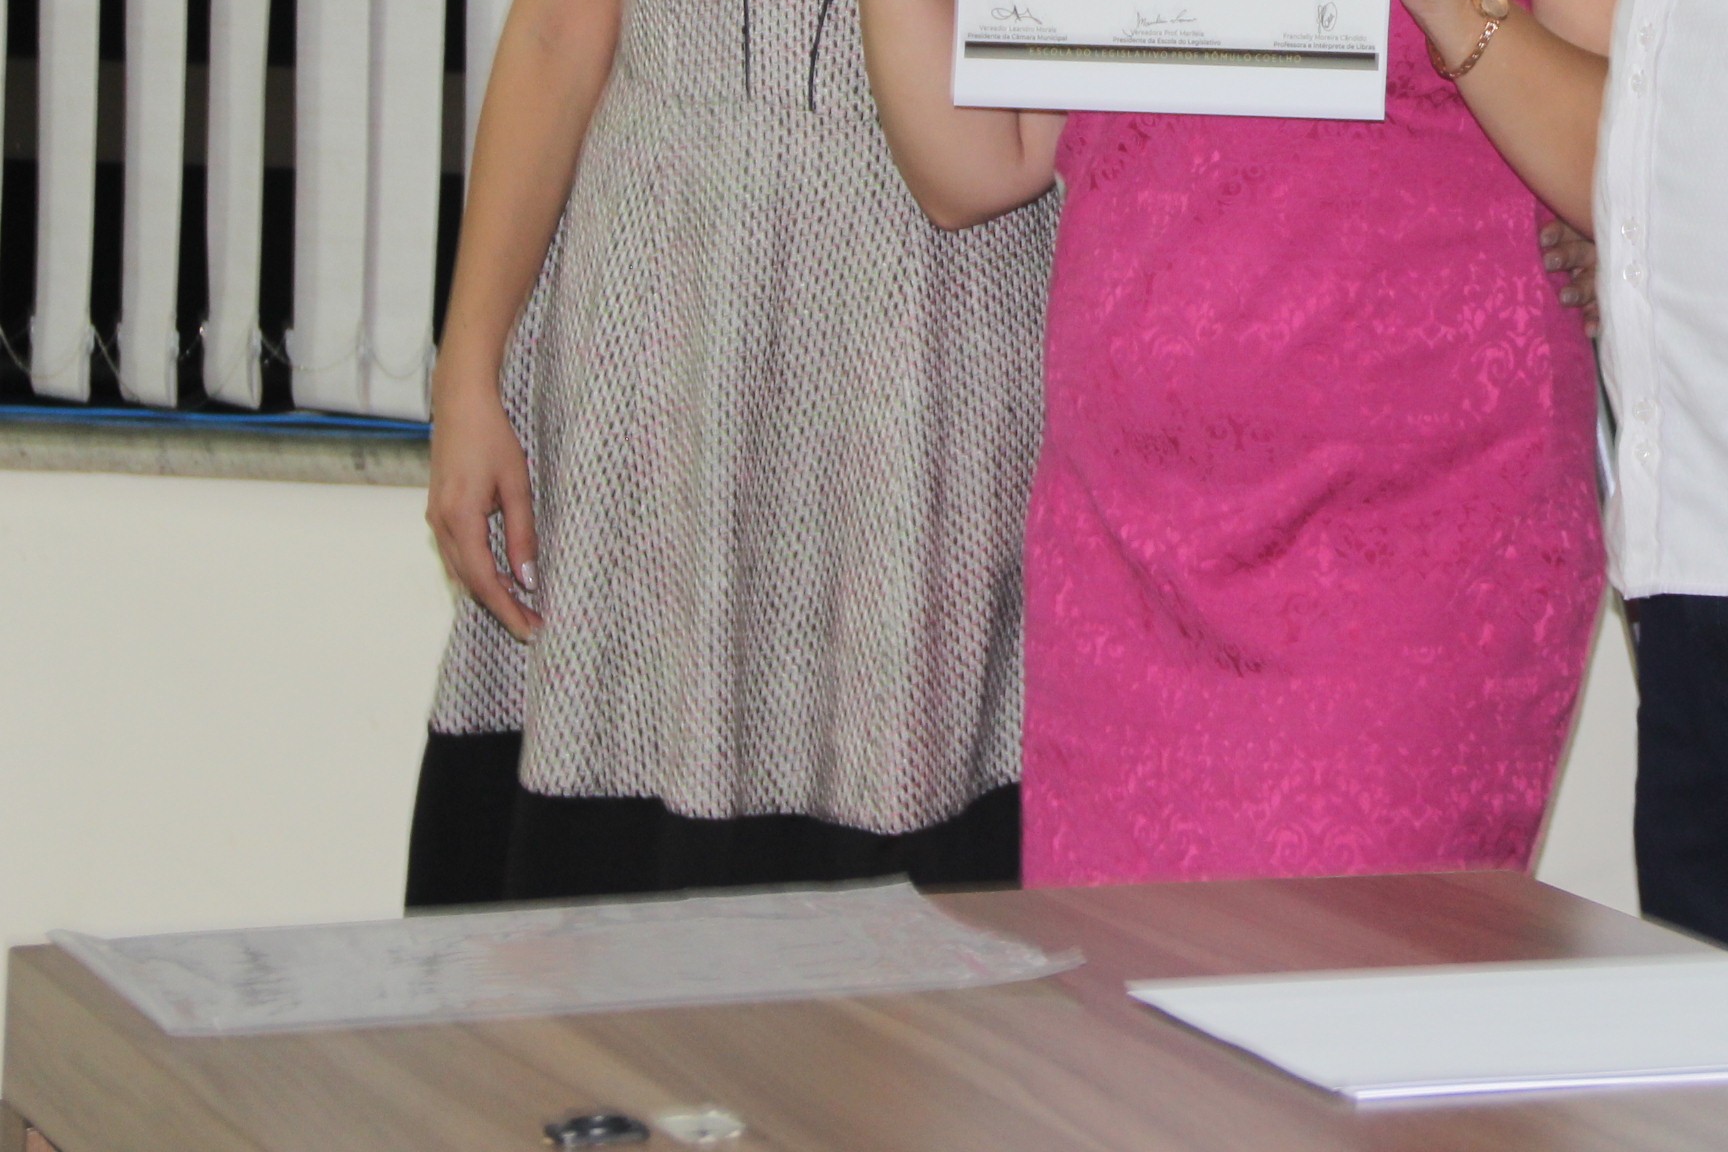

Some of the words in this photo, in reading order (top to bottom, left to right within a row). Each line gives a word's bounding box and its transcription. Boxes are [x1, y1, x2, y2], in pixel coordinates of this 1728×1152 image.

[1029, 47, 1073, 56] ESCOLA
[1075, 48, 1092, 57] DO
[1094, 49, 1169, 59] LEGISLATIVO
[1255, 53, 1301, 63] COELHO
